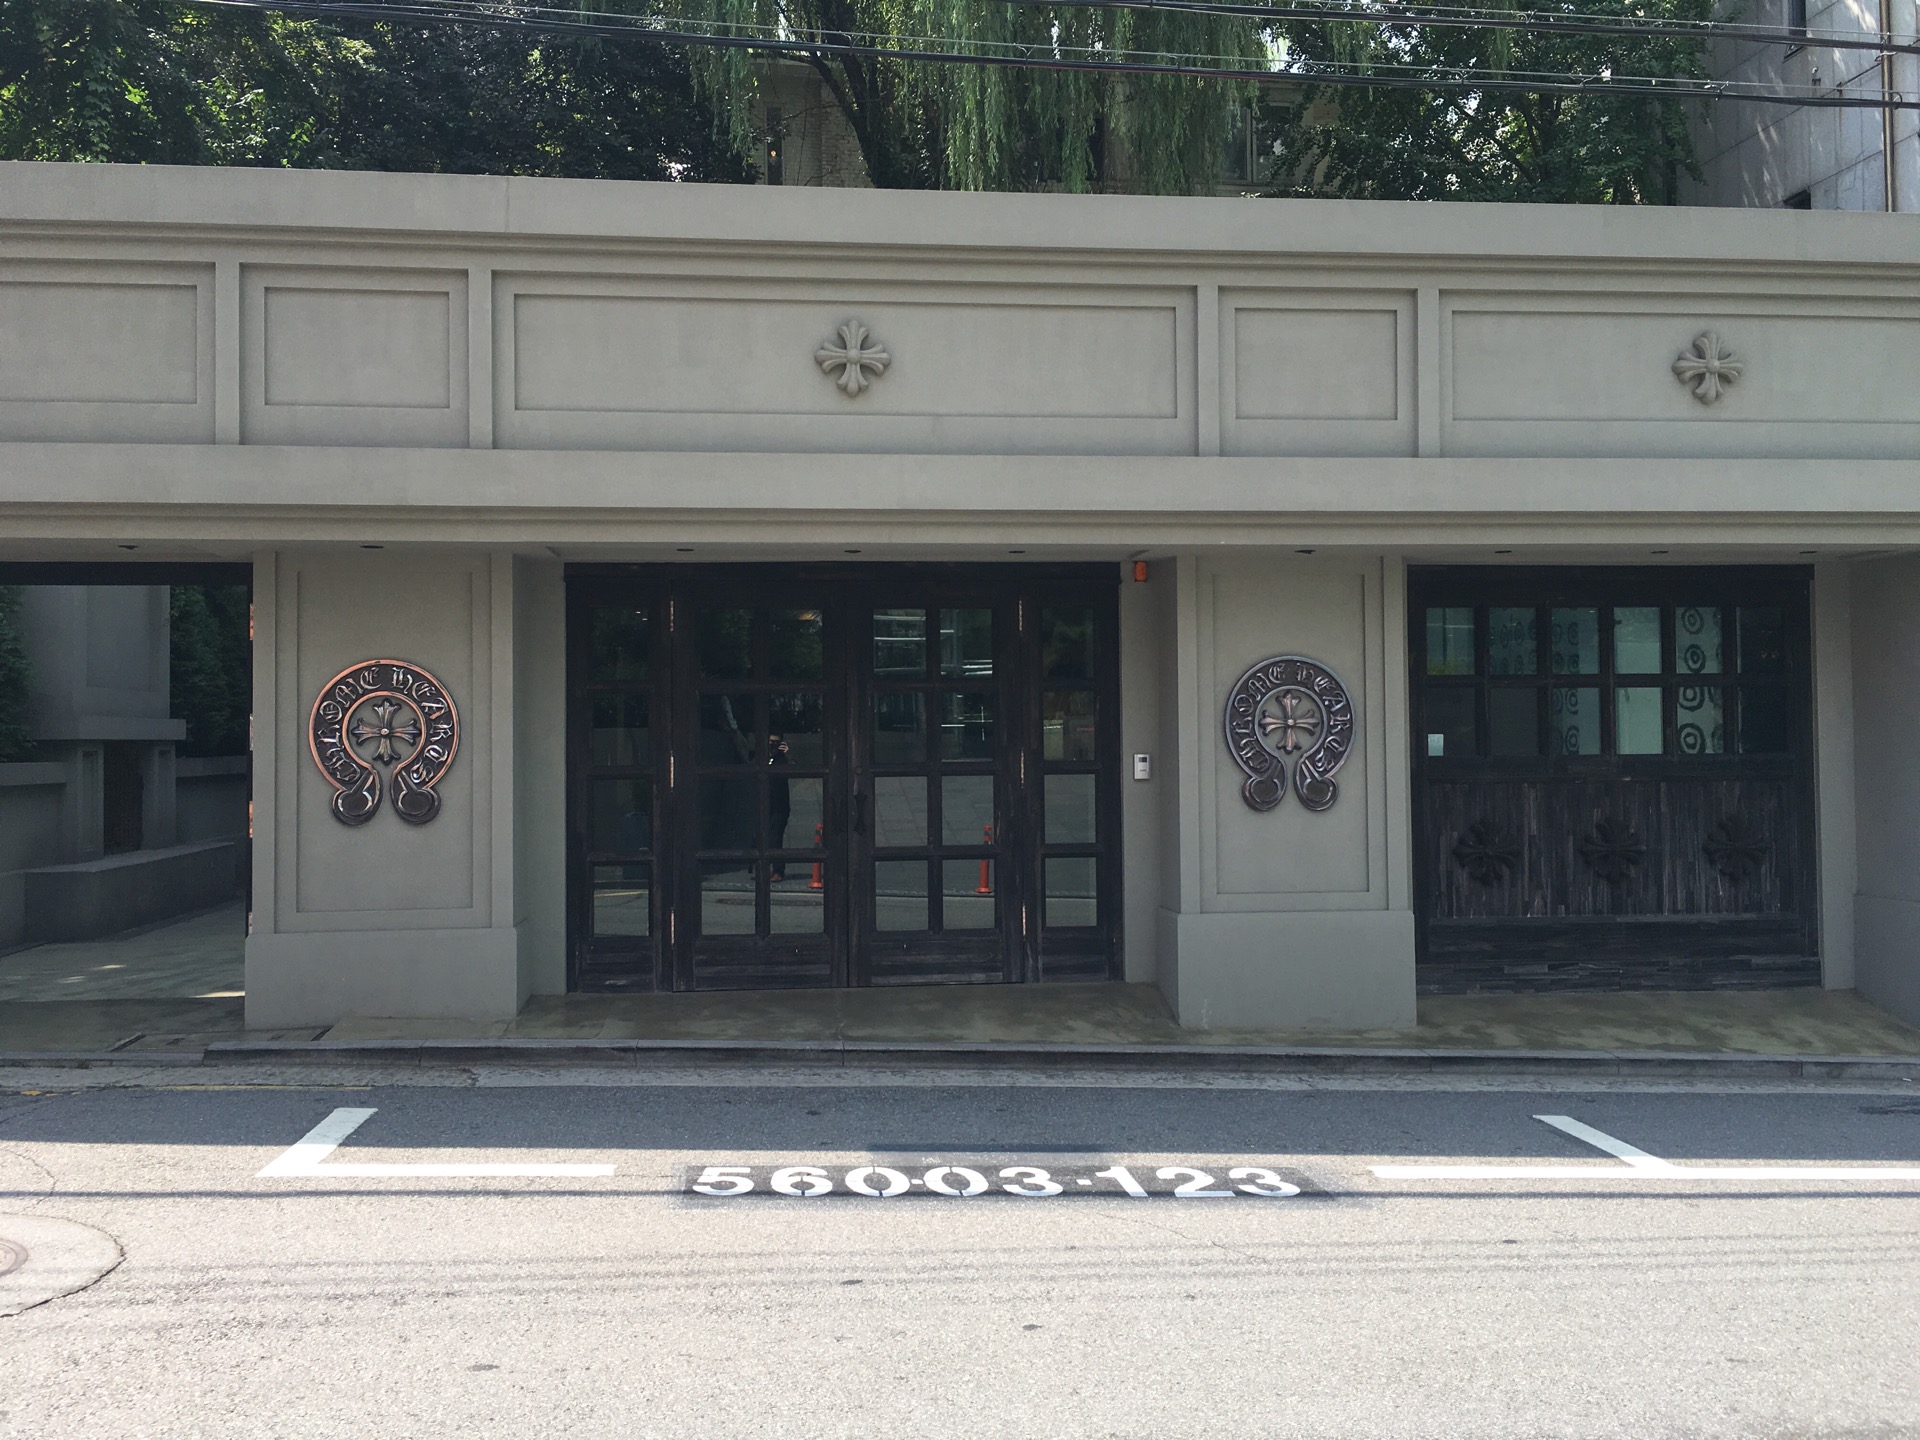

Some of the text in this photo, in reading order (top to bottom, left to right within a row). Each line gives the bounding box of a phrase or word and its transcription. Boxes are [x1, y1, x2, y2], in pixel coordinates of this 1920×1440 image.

[317, 667, 453, 783] CHROME HEARTS
[1232, 663, 1351, 772] CHROME HEARTS
